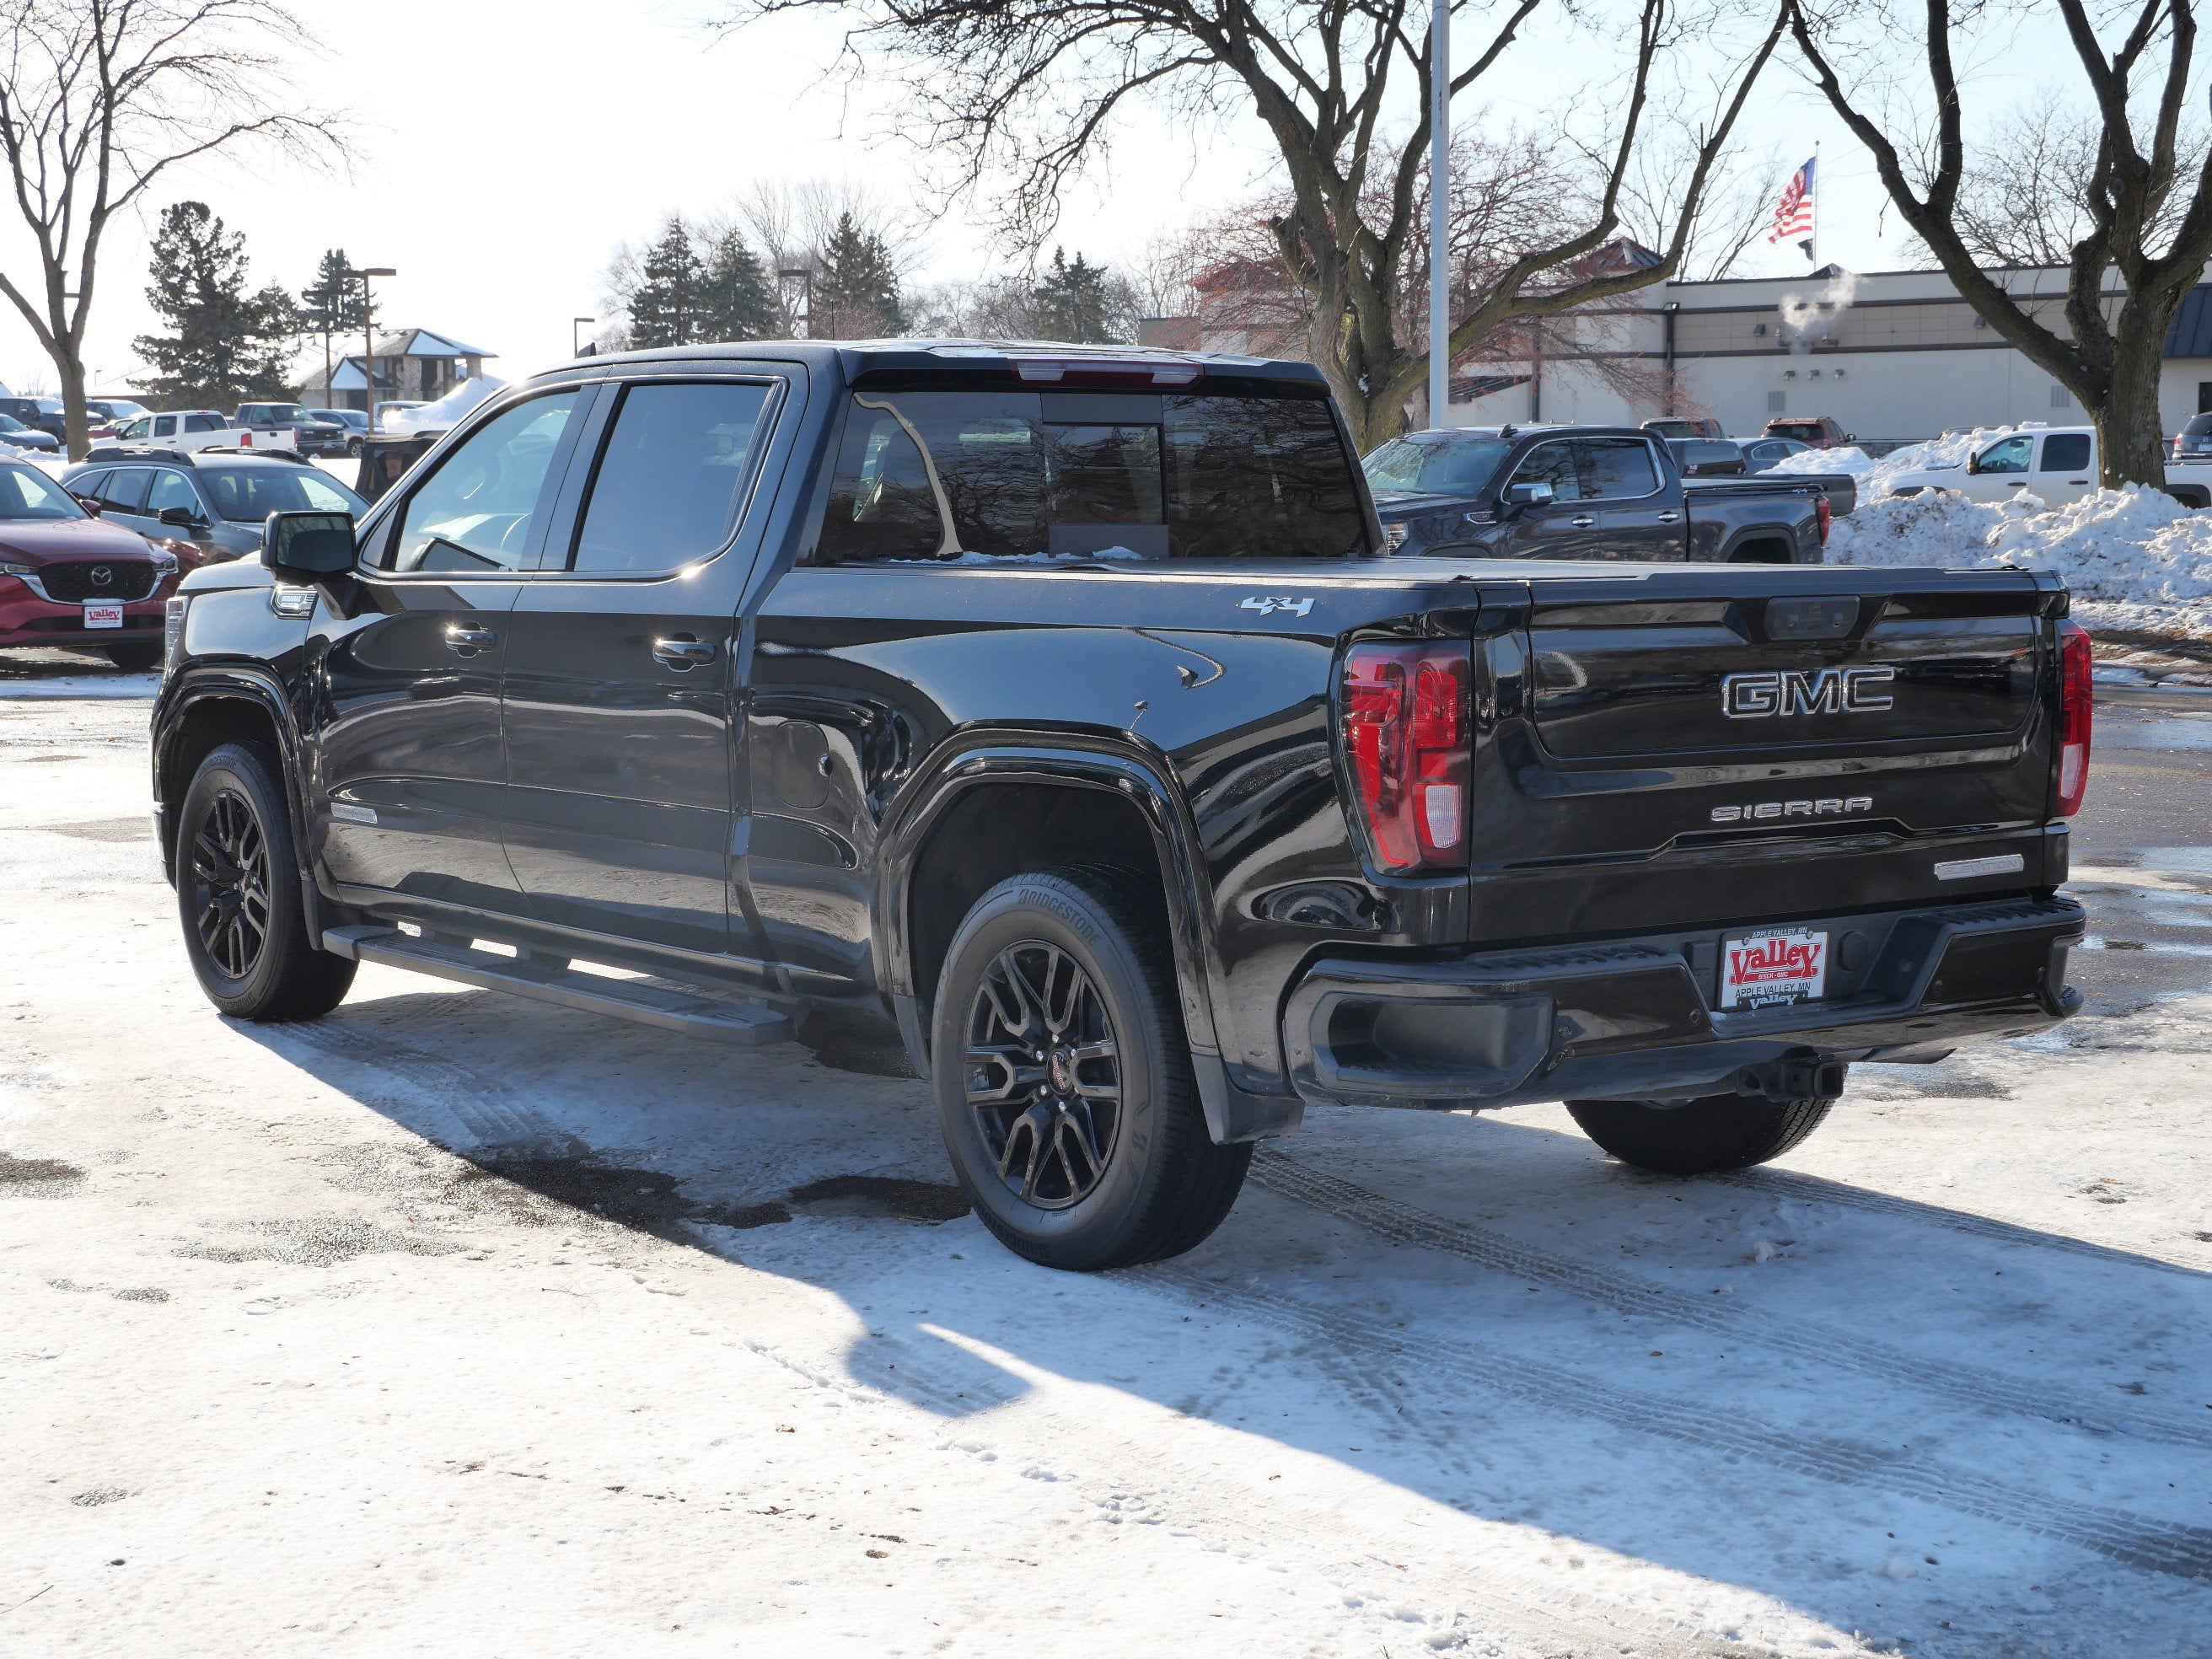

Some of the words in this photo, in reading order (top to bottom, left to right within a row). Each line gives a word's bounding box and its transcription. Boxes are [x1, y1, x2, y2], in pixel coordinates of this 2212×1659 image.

[1721, 666, 1895, 719] GMC
[1710, 796, 1873, 823] SIERRA
[1016, 888, 1102, 945] BRIDGESTONE
[1751, 930, 1772, 939] APPLE
[1798, 926, 1807, 935] MN
[1730, 938, 1822, 986] Valley
[1735, 987, 1762, 998] APPLE
[1797, 982, 1811, 991] MN
